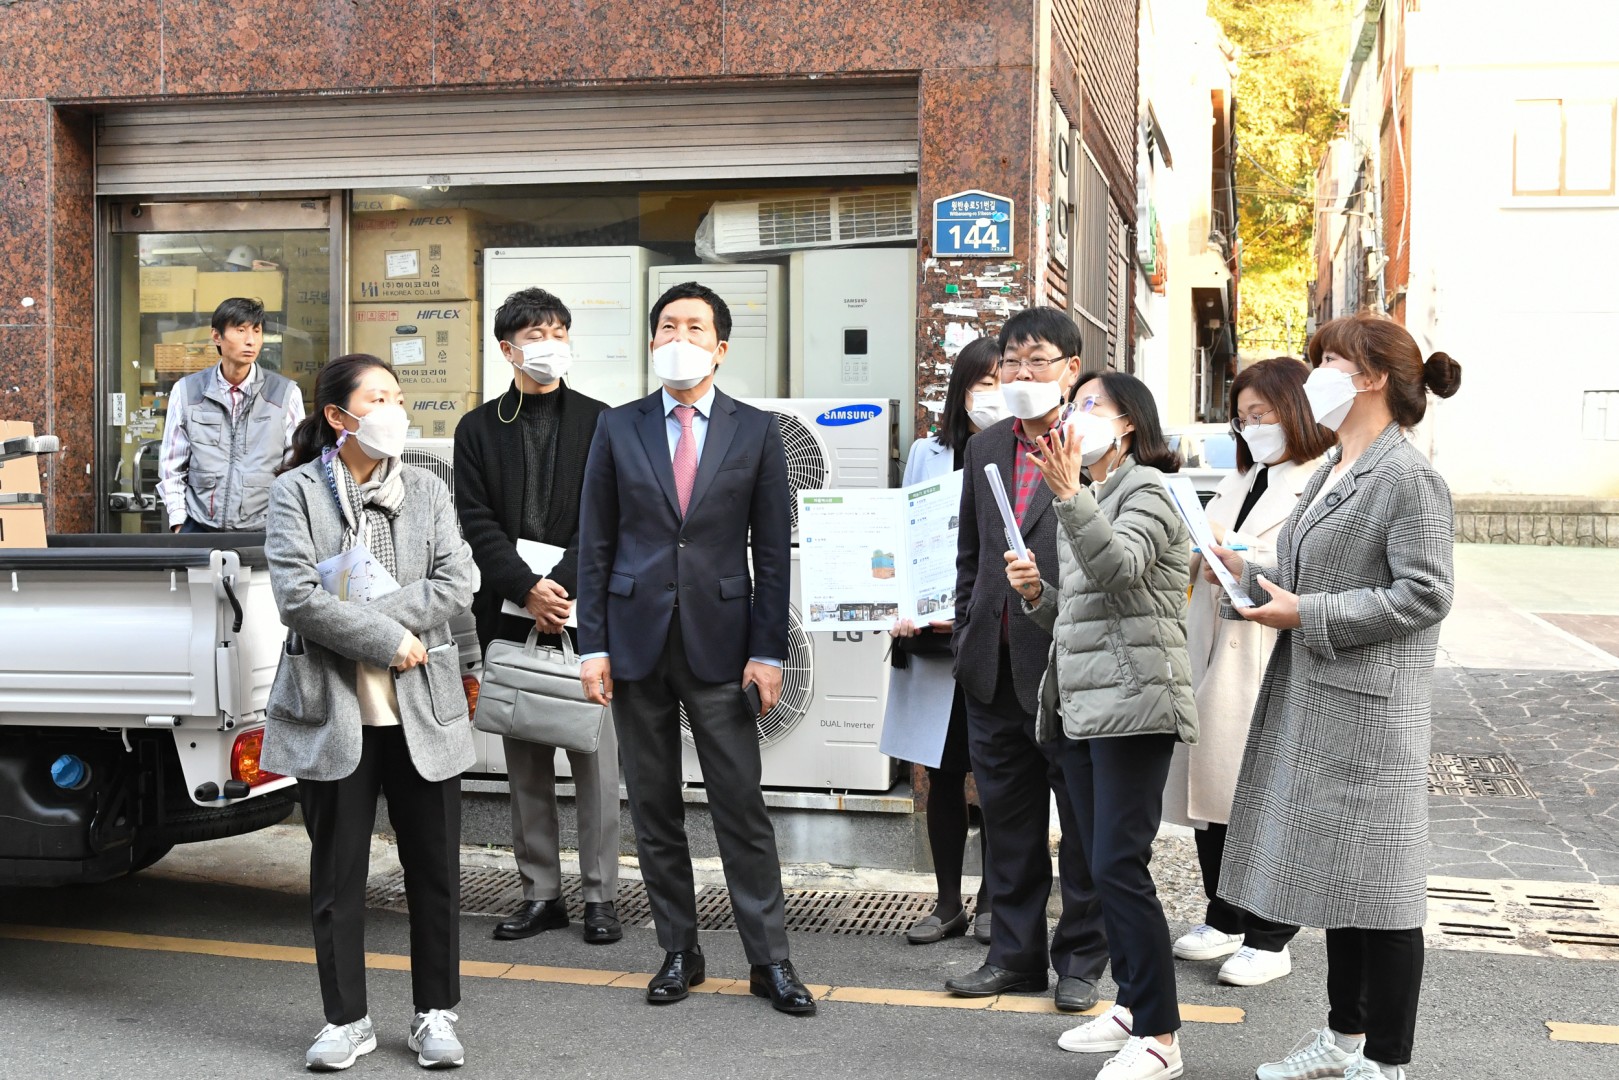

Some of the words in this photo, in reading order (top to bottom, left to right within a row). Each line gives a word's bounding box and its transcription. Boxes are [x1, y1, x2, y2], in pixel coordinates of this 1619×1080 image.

[951, 201, 996, 211] 윗반송로51번길
[408, 216, 453, 226] HIFLEX
[949, 224, 1000, 249] 144
[416, 309, 461, 319] HIFLEX
[413, 401, 457, 410] HIFLEX
[823, 410, 875, 420] SAMSUNG
[832, 630, 863, 643] LG
[820, 719, 842, 728] DUAL
[843, 720, 876, 729] Inverter
